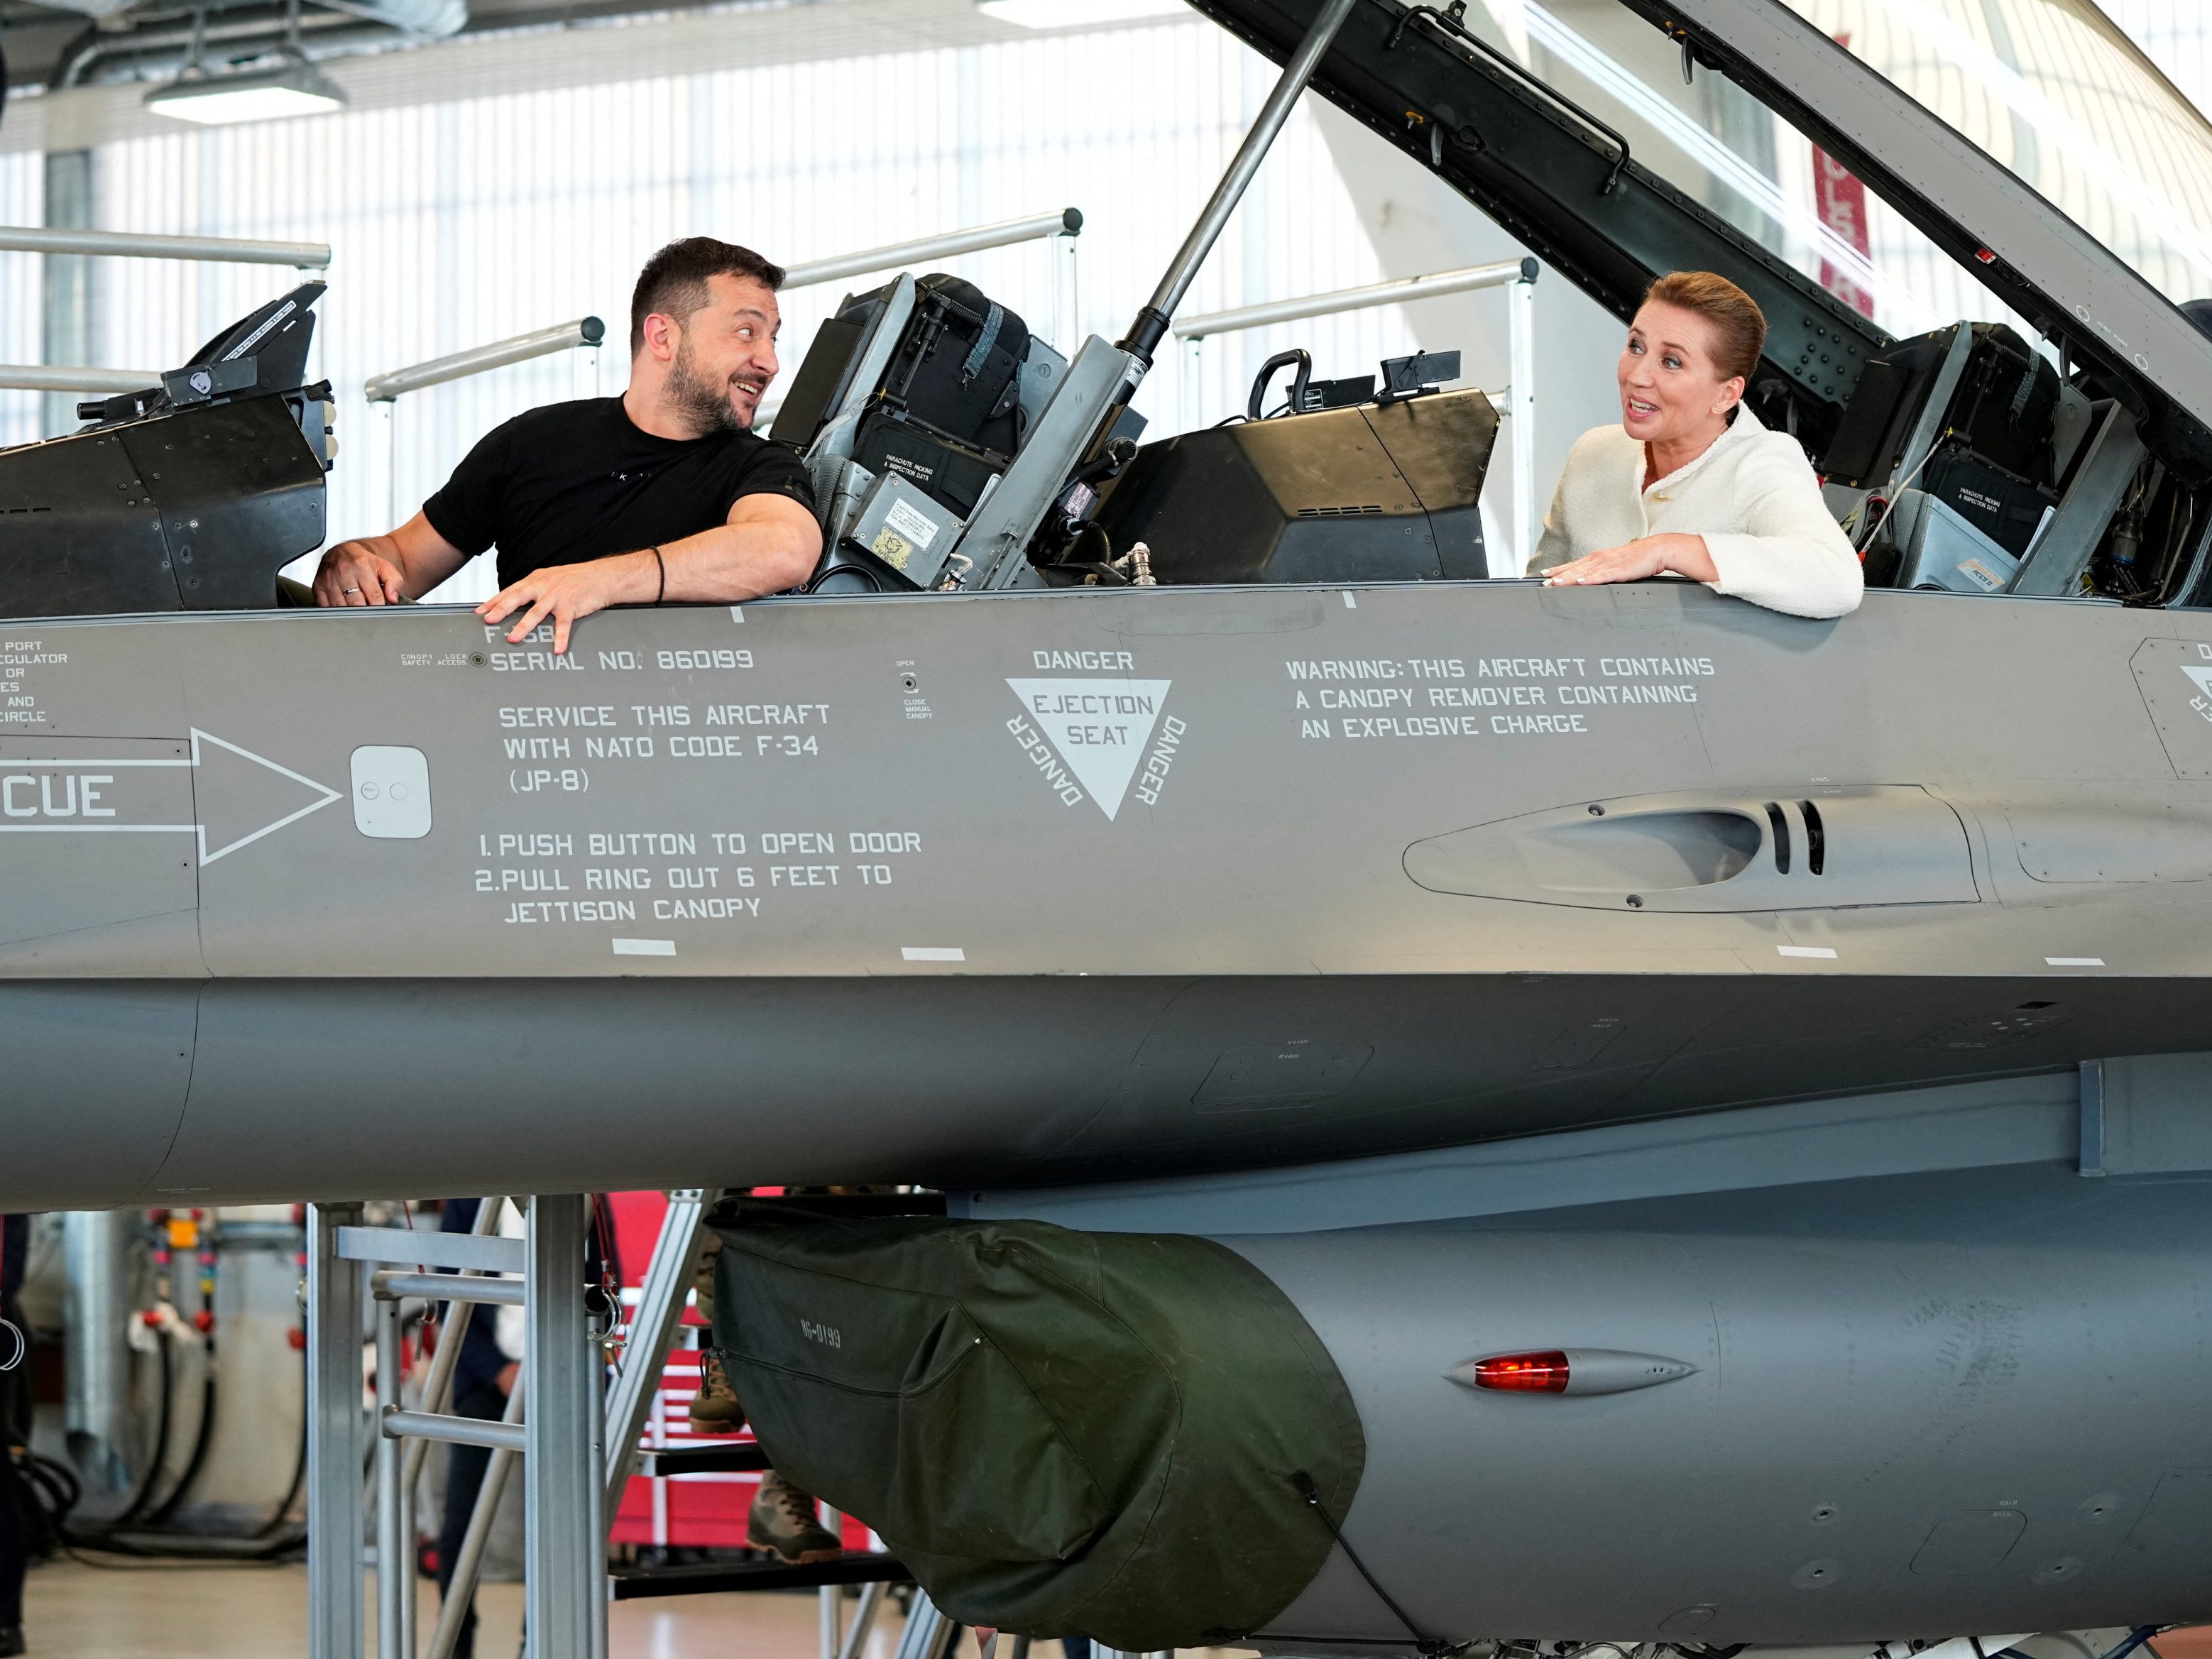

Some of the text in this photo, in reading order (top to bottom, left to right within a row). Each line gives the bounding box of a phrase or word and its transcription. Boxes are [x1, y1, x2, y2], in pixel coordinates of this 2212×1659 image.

[886, 454, 933, 475] PARACHUTE PACKING
[889, 463, 916, 478] INSPECTION
[916, 471, 929, 481] DATA
[1960, 487, 2000, 508] PARACHUTE PACKING
[1964, 495, 1986, 508] INSPECTION
[1986, 503, 1998, 513] DATA
[1972, 569, 1988, 583] ACES
[5, 642, 42, 651] PORT
[491, 652, 584, 671] SERIAL
[657, 650, 753, 669] 860199
[1034, 651, 1134, 669] DANGER
[1286, 657, 1714, 679] WARNING: THIS AIRCRAFT CONTAINS
[6, 668, 25, 678] OR
[7, 696, 34, 707] AND
[1034, 695, 1153, 713] EJECTION
[1296, 685, 1697, 709] A CANOPY REMOVER CONTAINING
[500, 703, 830, 728] SERVICE THIS AIRCRAFT
[1301, 714, 1588, 738] AN EXPLOSIVE CHARGE
[1068, 726, 1128, 745] SEAT
[504, 735, 818, 759] WITH NATO CODE F-34
[1006, 715, 1083, 806] DANGER
[1134, 715, 1187, 806] DANGER
[510, 768, 588, 793] (JP-8)
[3, 775, 116, 817] CUE
[589, 833, 696, 855] BUTTON
[712, 833, 745, 855] TO
[762, 833, 834, 854] OPEN
[850, 832, 921, 853] DOOR
[586, 868, 651, 890] RING
[668, 867, 719, 889] OUT
[737, 867, 755, 887] 6
[770, 866, 839, 887] FEET
[857, 865, 892, 885] TO
[505, 898, 760, 924] JETTISON CANOPY
[801, 1318, 841, 1349] 86-0199
